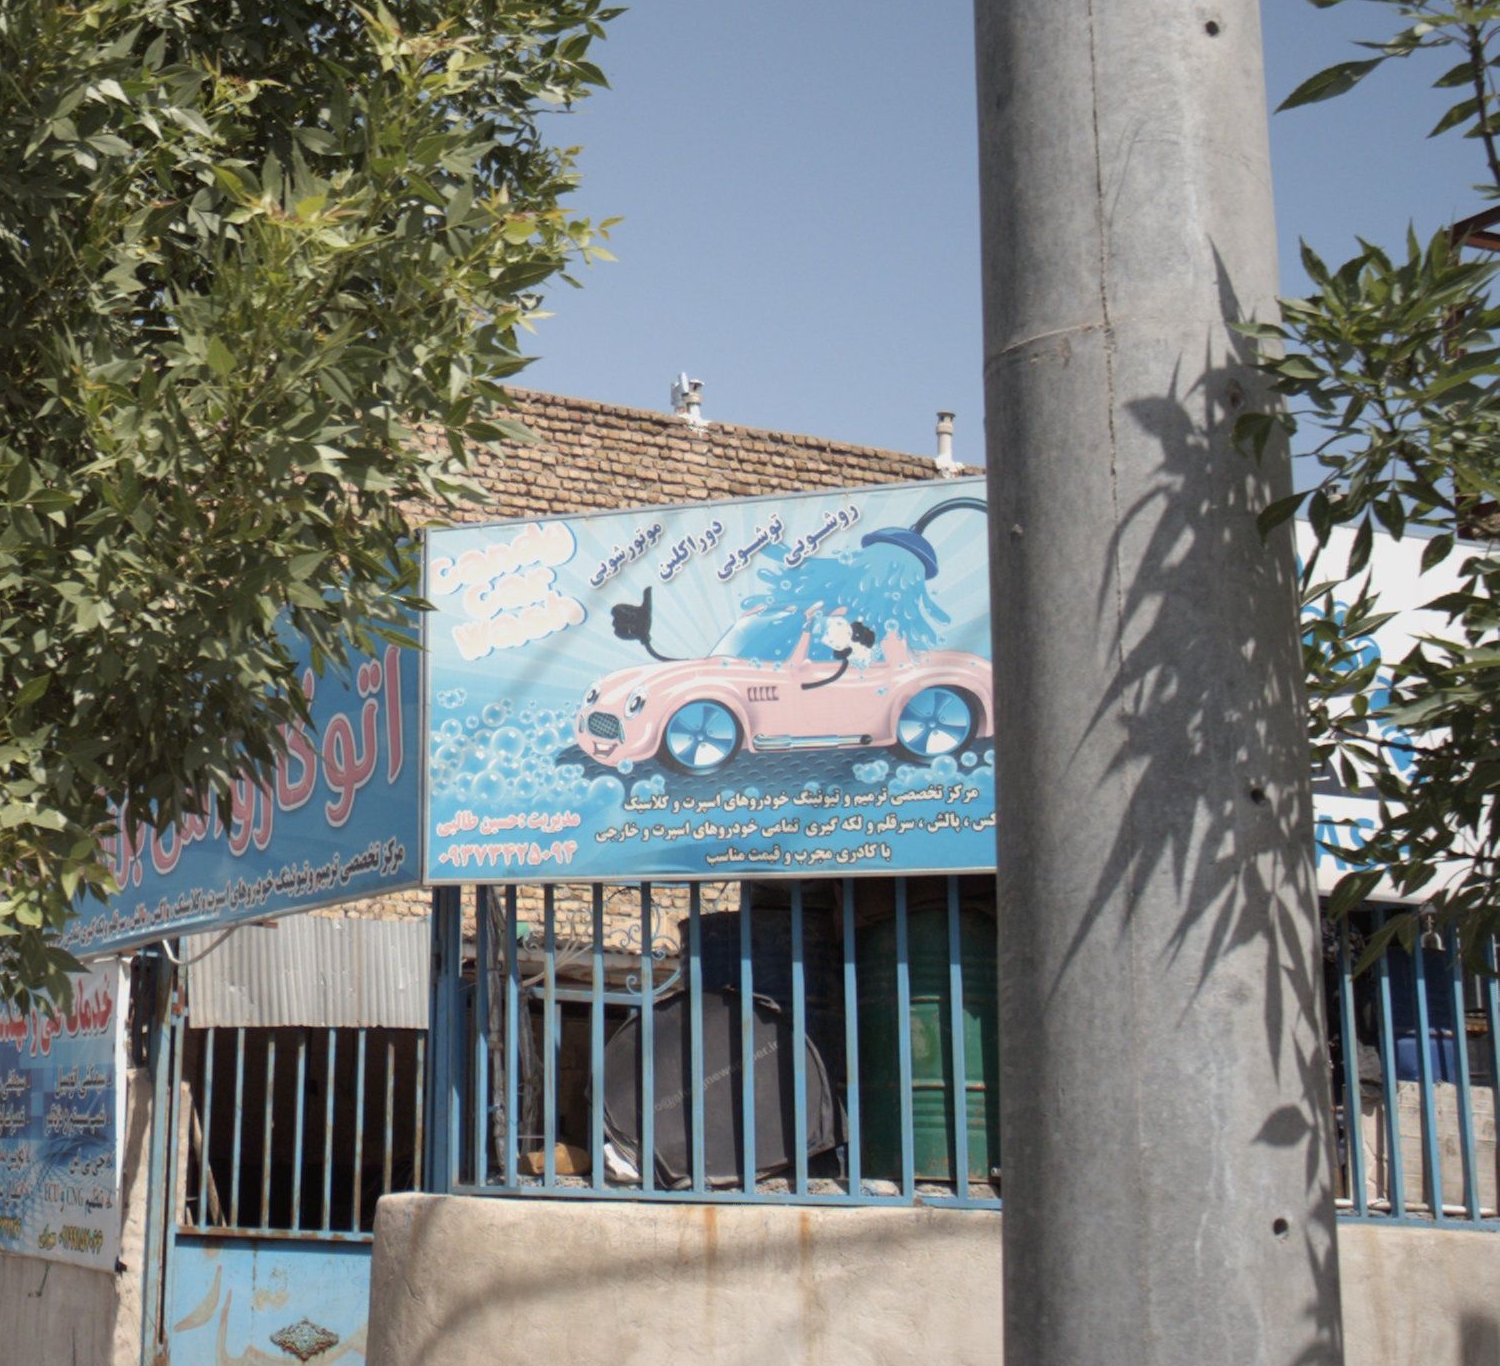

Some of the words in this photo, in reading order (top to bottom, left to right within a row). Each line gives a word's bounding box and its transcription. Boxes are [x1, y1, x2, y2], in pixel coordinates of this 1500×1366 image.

[623, 794, 670, 814] کلاسیک
[682, 794, 721, 813] اسپرت
[723, 791, 790, 812] خودروهای
[792, 788, 841, 808] تیونینگ
[843, 793, 851, 808] و
[853, 787, 888, 808] ترمیم
[890, 784, 944, 806] تخصصی
[946, 784, 979, 804] مرکز
[672, 798, 680, 814] و
[595, 822, 639, 844] خارجی
[651, 822, 690, 841] اسپرت
[693, 818, 759, 840] خودروهای
[760, 817, 800, 837] تمامی
[805, 816, 839, 837] گیری
[841, 814, 863, 832] لکه
[866, 819, 874, 834] و
[641, 827, 650, 841] و
[380, 835, 405, 877] مرکز
[706, 846, 745, 867] مناسب
[747, 843, 781, 864] قیمت
[784, 850, 792, 866] و
[835, 843, 878, 864] کادری
[880, 843, 892, 861] با
[340, 841, 381, 886] تخصصی
